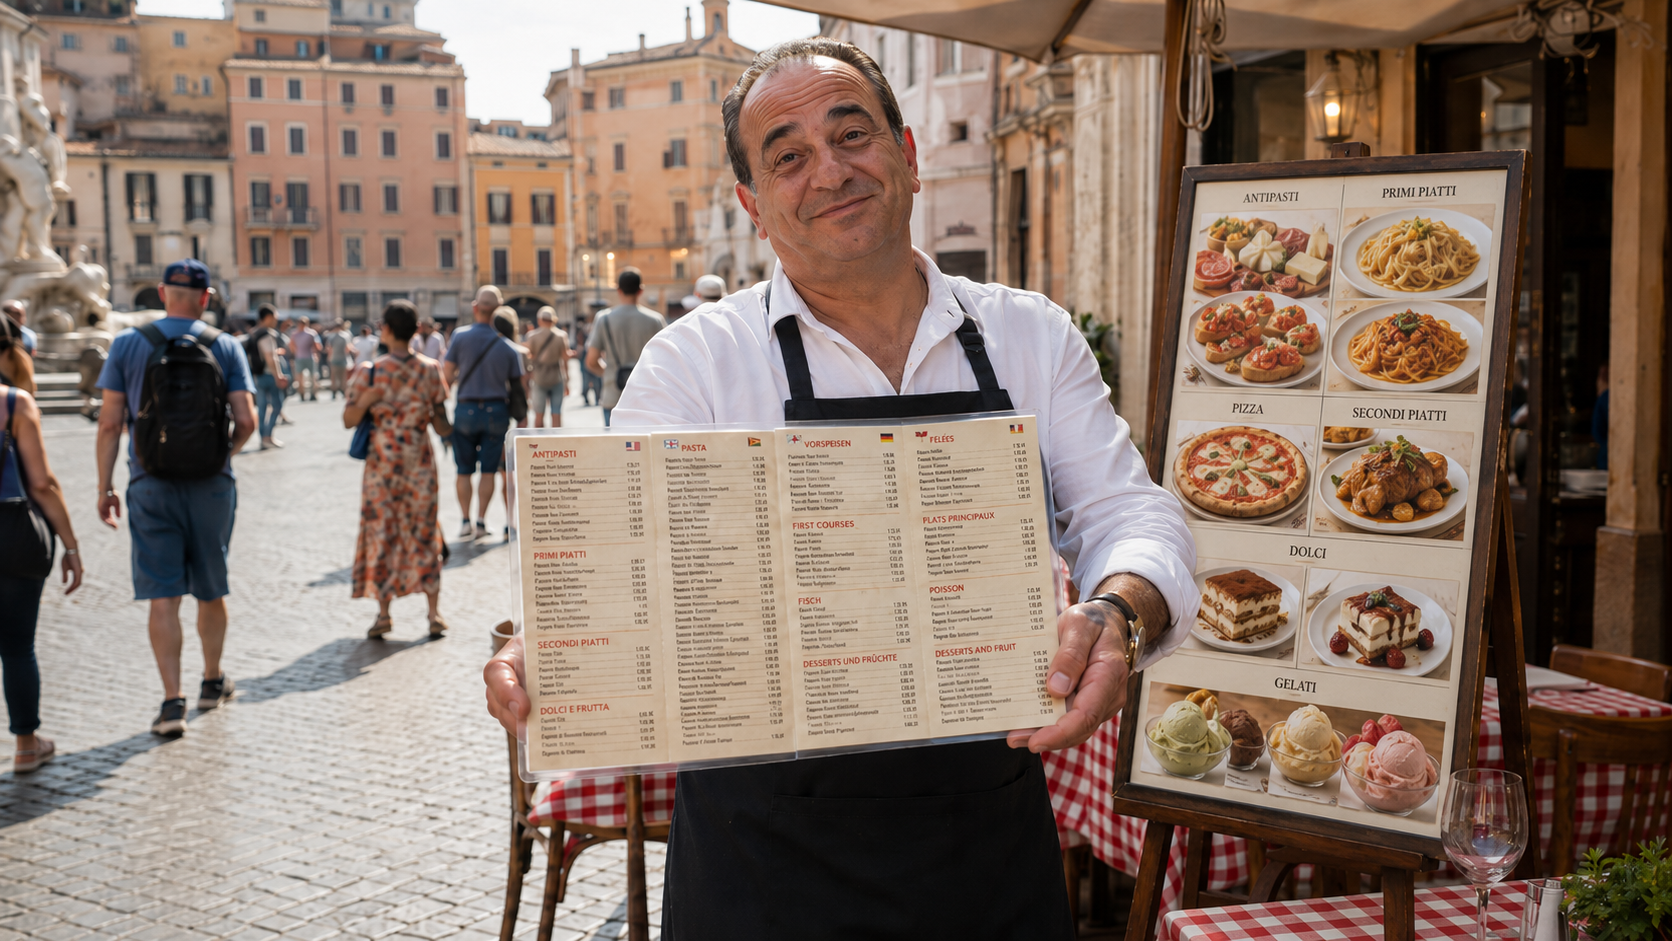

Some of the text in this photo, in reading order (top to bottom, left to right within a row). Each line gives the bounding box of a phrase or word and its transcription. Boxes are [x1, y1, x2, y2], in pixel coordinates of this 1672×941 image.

[1244, 192, 1298, 202] ANTIPASTI
[1383, 186, 1456, 198] PRIMI PIATTI
[1233, 403, 1263, 414] PIZZA
[1353, 408, 1446, 421] SECONDI PIATTI
[805, 440, 851, 448] VORSPEISEN
[532, 450, 576, 458] ANTIPASTI
[923, 512, 994, 524] PLATS PRINCIPAUX
[793, 521, 854, 530] FIRST COURSES
[534, 551, 586, 560] PRIMI PIATTI
[1290, 546, 1326, 558] DOLCI
[930, 585, 964, 593] POISSON
[538, 638, 609, 649] SECONDI PIATTI
[935, 643, 1016, 657] DESSERTS AND FRUIT
[804, 659, 841, 668] DESSERTS
[843, 657, 860, 665] UND
[1275, 678, 1316, 693] GELATI
[540, 704, 609, 715] DOLCI E FRUTTA
